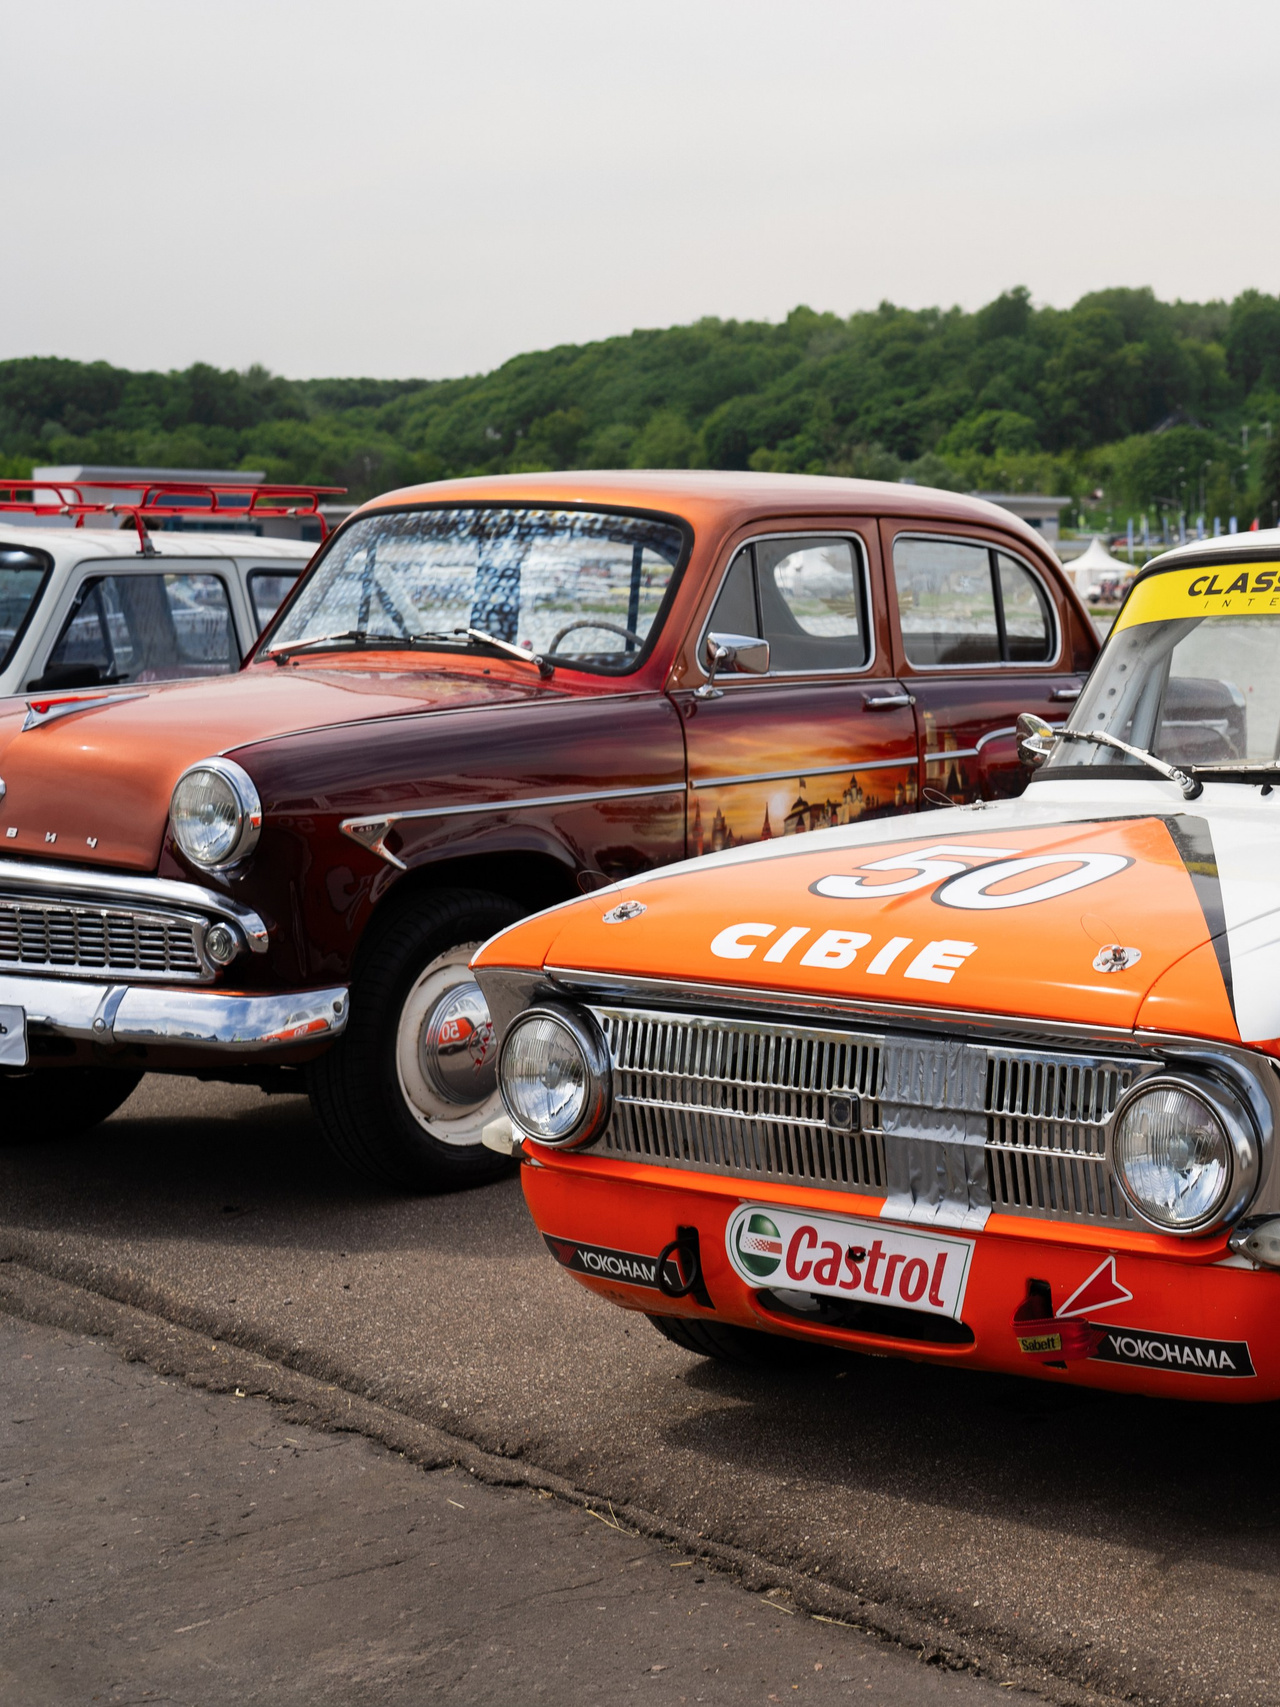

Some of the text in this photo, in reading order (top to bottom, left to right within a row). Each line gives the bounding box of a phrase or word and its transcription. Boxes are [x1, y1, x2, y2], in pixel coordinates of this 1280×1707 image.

[807, 844, 1137, 911] 50
[785, 1225, 948, 1308] Castrol
[1021, 1336, 1056, 1352] Sabelt
[1108, 1334, 1237, 1370] YOKOHAMA
